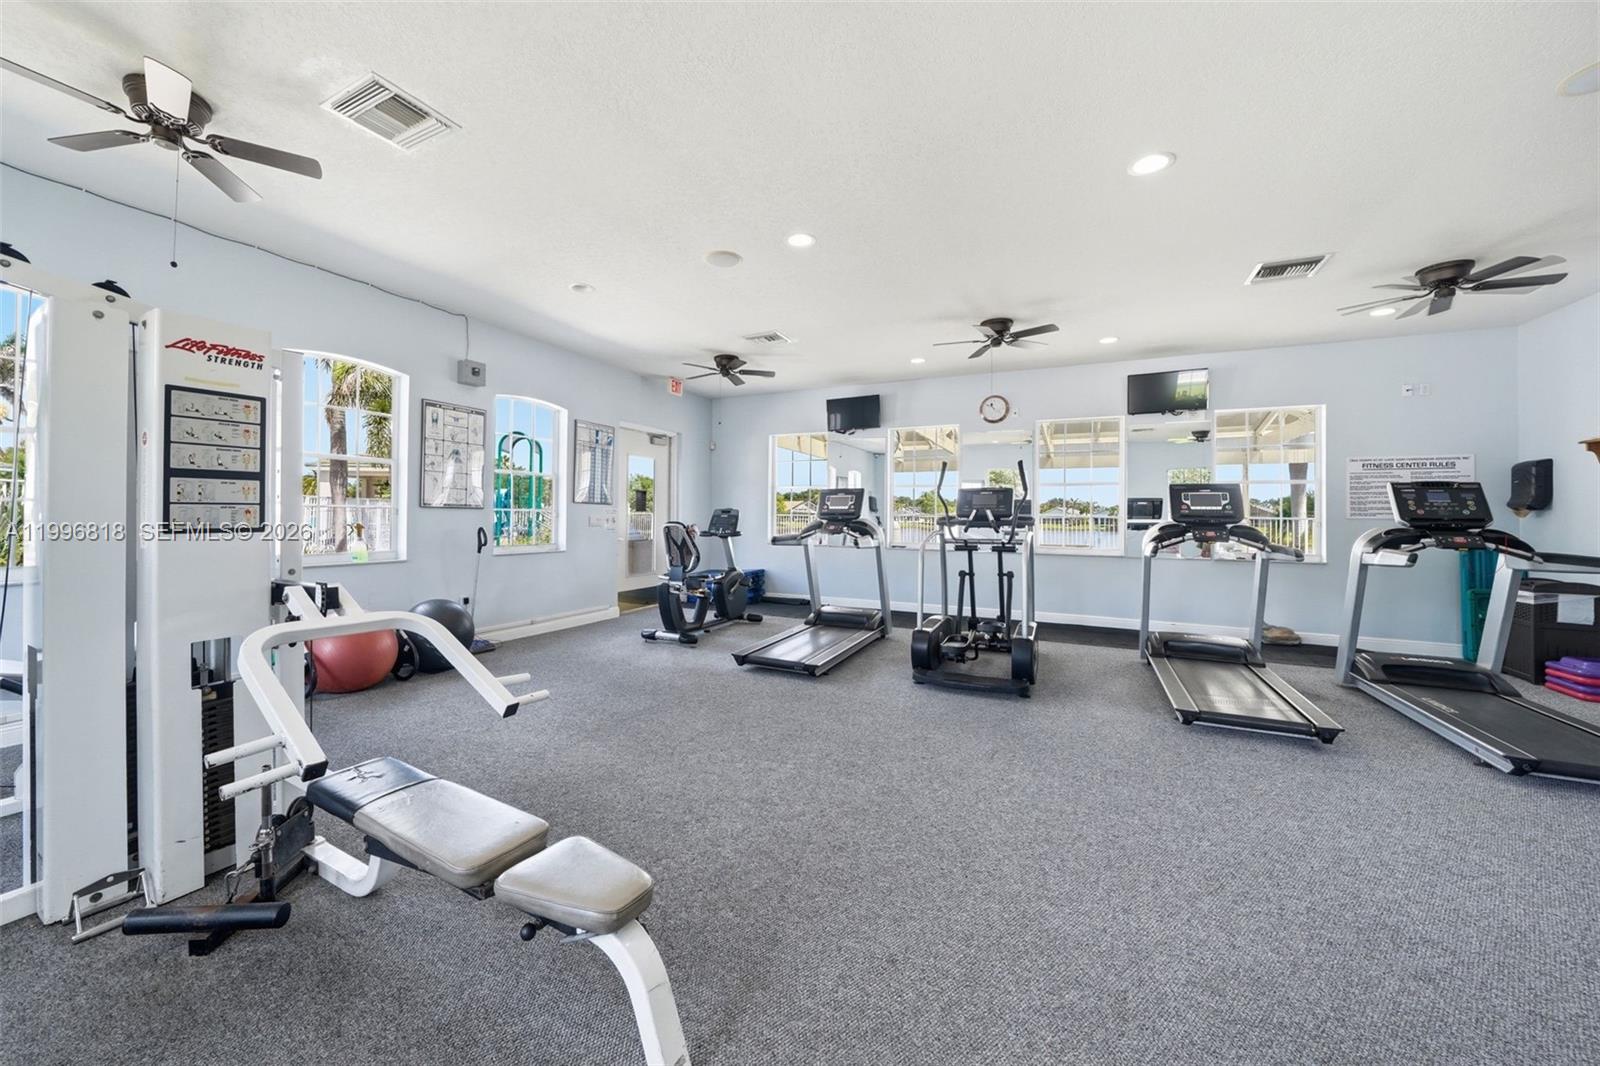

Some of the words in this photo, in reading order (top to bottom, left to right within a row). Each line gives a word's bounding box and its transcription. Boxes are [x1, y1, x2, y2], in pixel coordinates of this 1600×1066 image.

[206, 355, 264, 370] STRENGTH
[1395, 461, 1428, 469] CENTER
[1428, 460, 1457, 468] RULES
